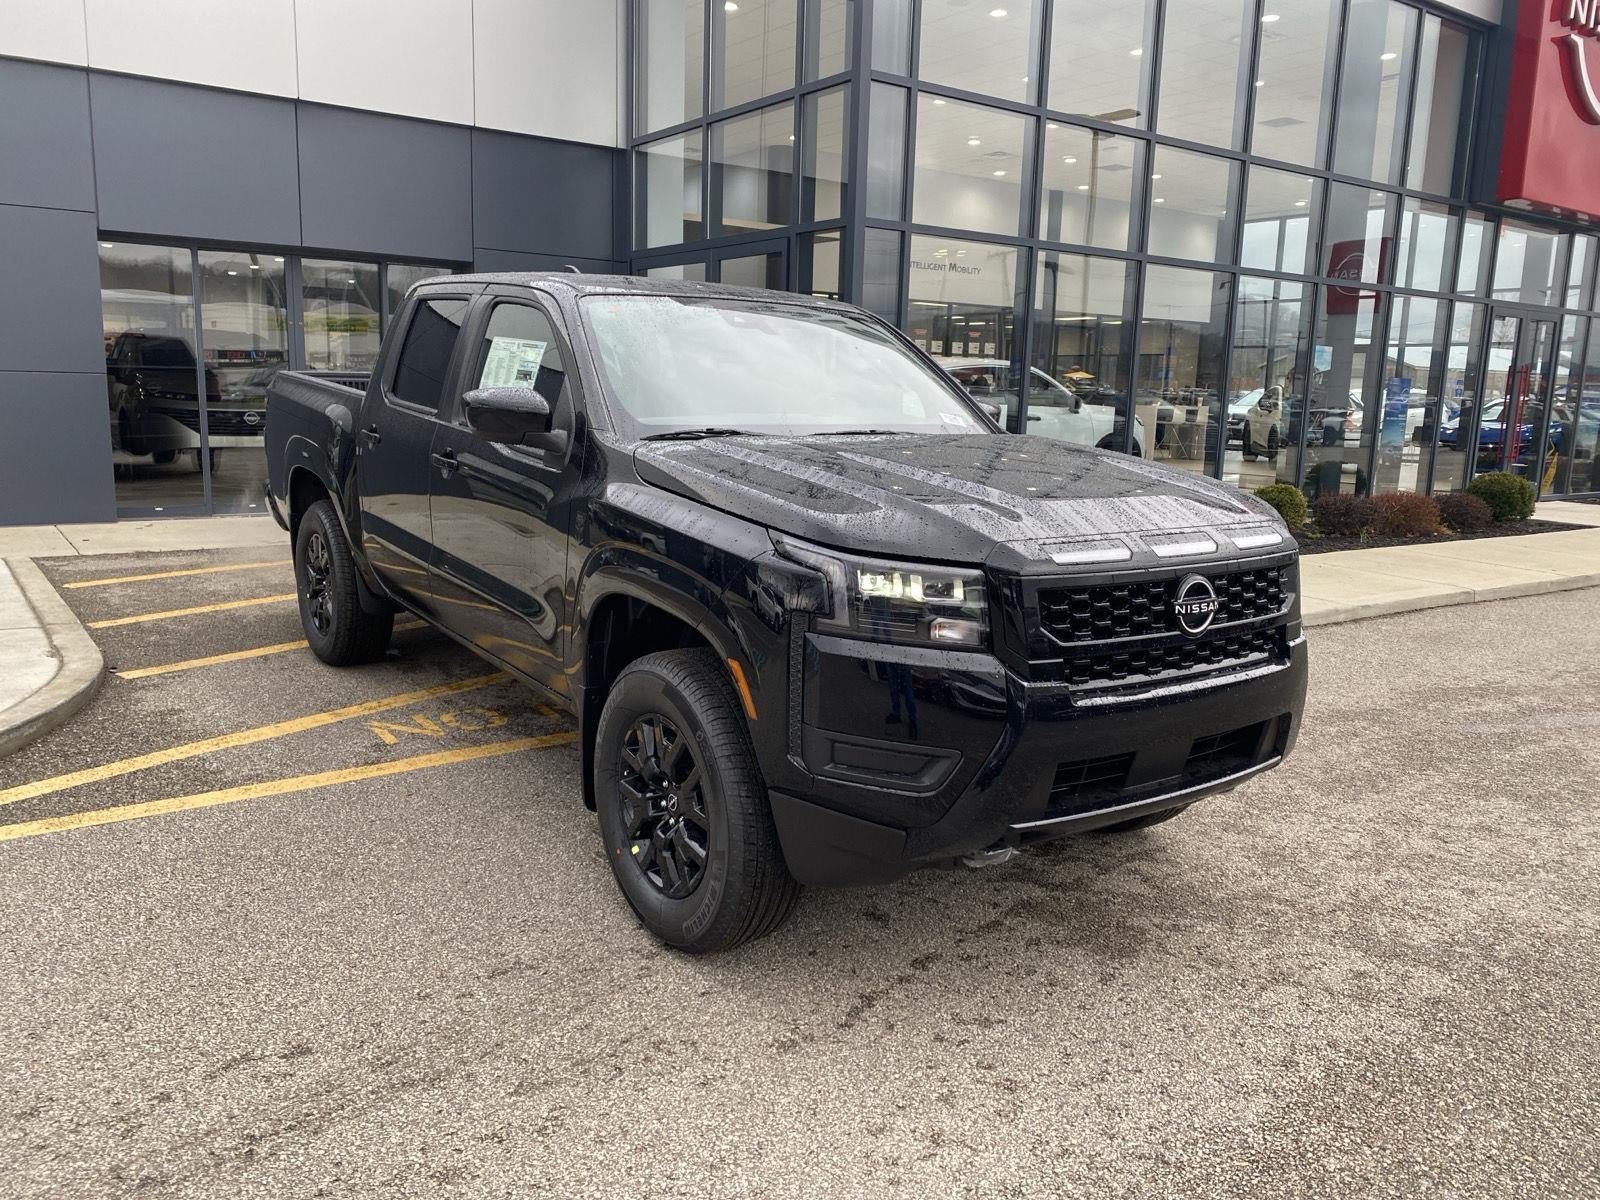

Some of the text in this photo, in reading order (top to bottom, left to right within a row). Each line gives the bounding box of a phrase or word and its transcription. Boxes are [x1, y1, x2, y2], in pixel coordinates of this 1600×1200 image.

[1569, 0, 1600, 31] NI
[1175, 601, 1218, 614] NISSAN
[366, 708, 508, 745] NO
